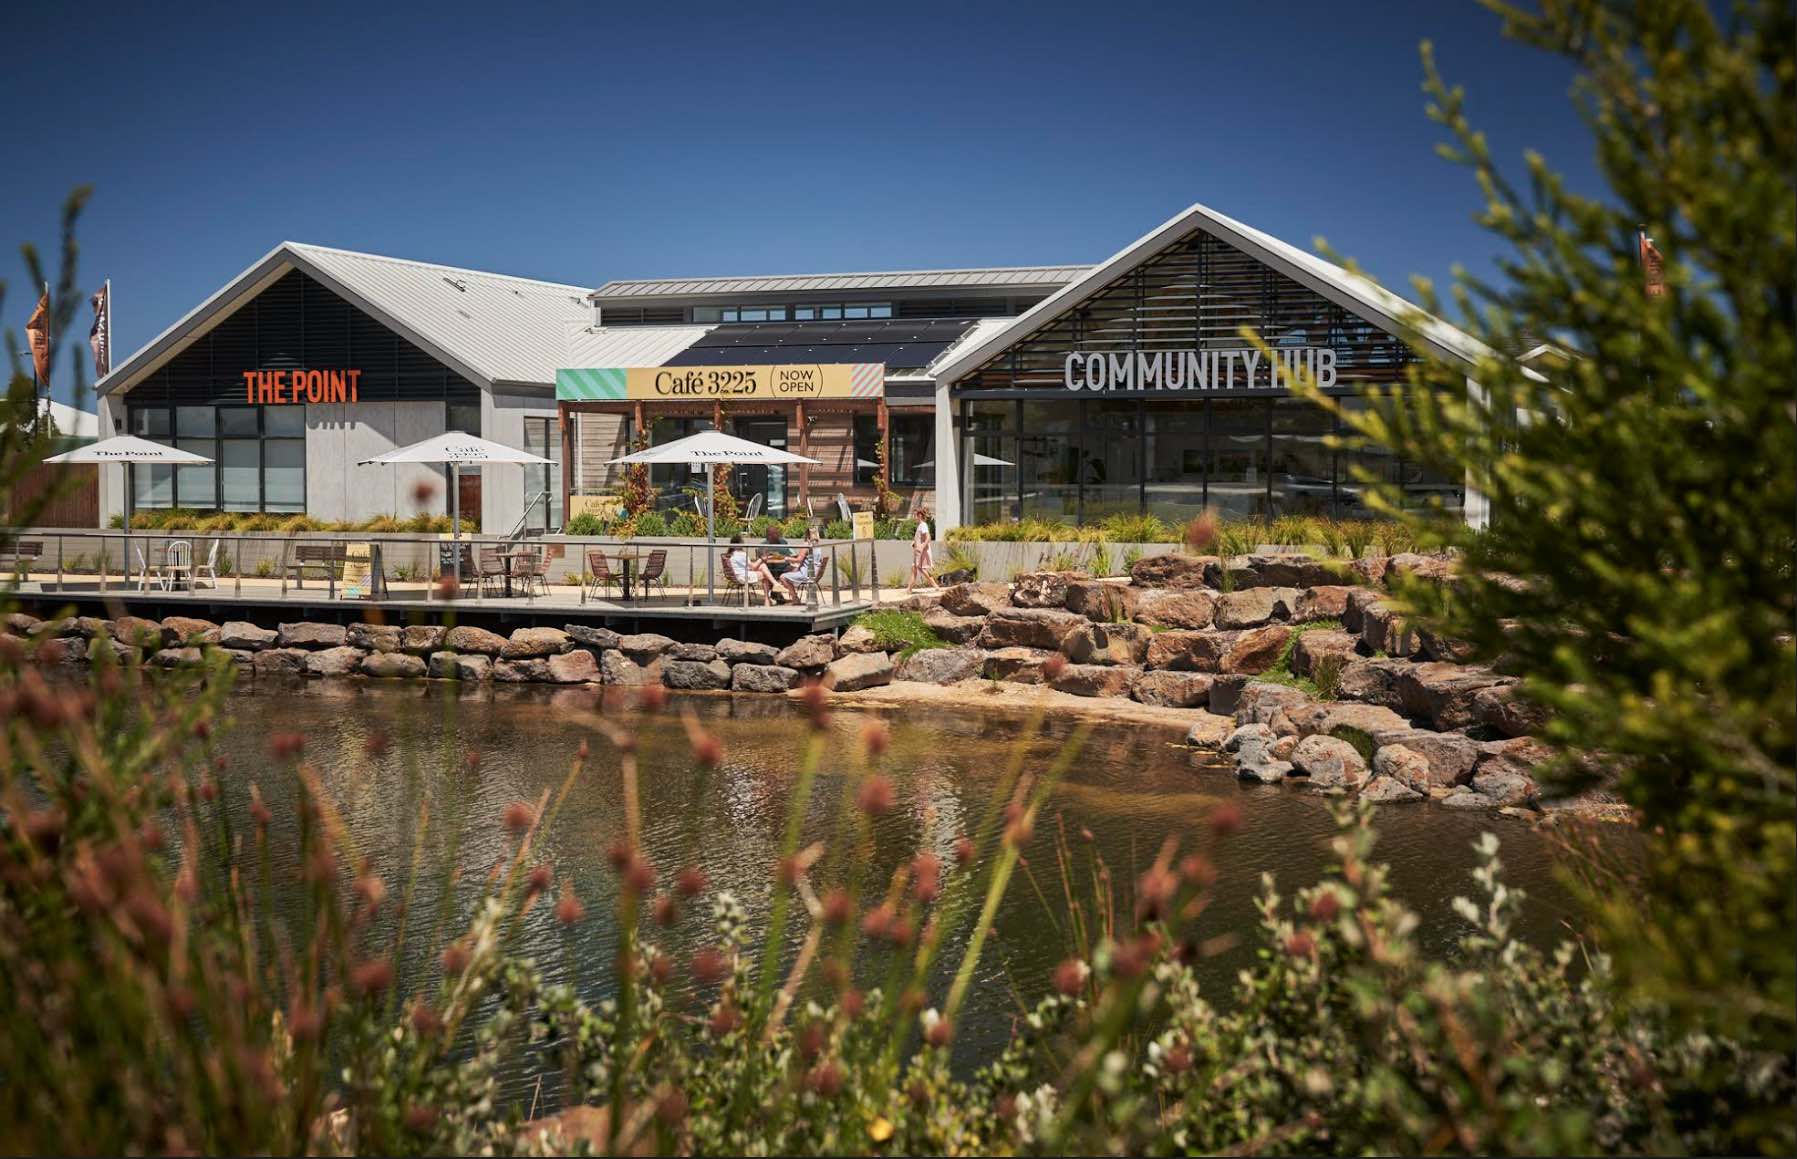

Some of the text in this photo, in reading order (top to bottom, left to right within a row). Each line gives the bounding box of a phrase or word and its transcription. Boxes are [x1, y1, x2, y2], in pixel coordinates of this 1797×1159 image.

[780, 370, 814, 380] NOW
[1064, 349, 1337, 391] COMMUNITY HUB
[243, 370, 361, 404] THE POINT
[655, 371, 757, 395] Café 3225
[779, 382, 814, 392] OPEN
